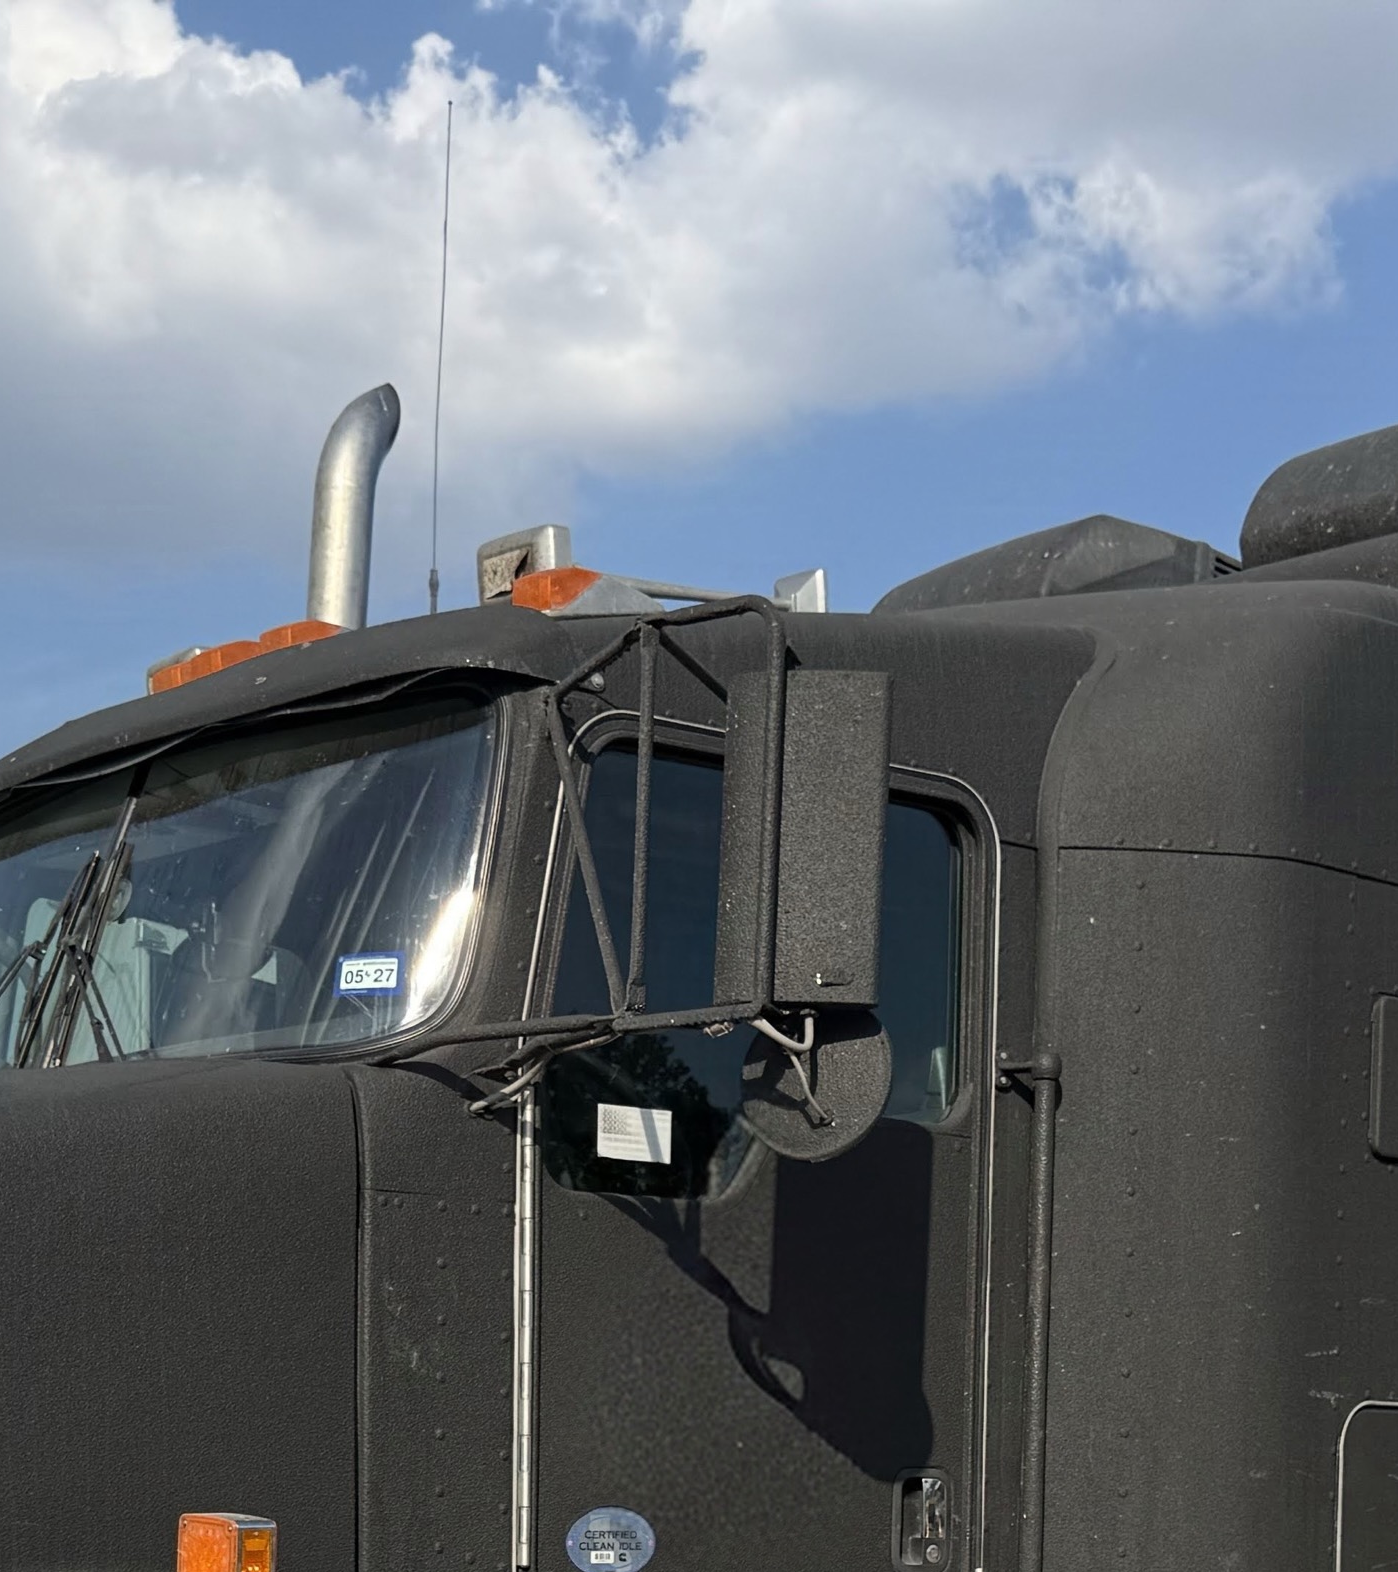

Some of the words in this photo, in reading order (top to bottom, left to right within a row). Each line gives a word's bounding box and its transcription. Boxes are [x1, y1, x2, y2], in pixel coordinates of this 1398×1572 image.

[344, 969, 364, 984] 05
[373, 968, 395, 983] 27
[584, 1530, 637, 1539] CERTIFIED
[579, 1542, 615, 1551] CLEAN
[618, 1542, 642, 1551] IDLE
